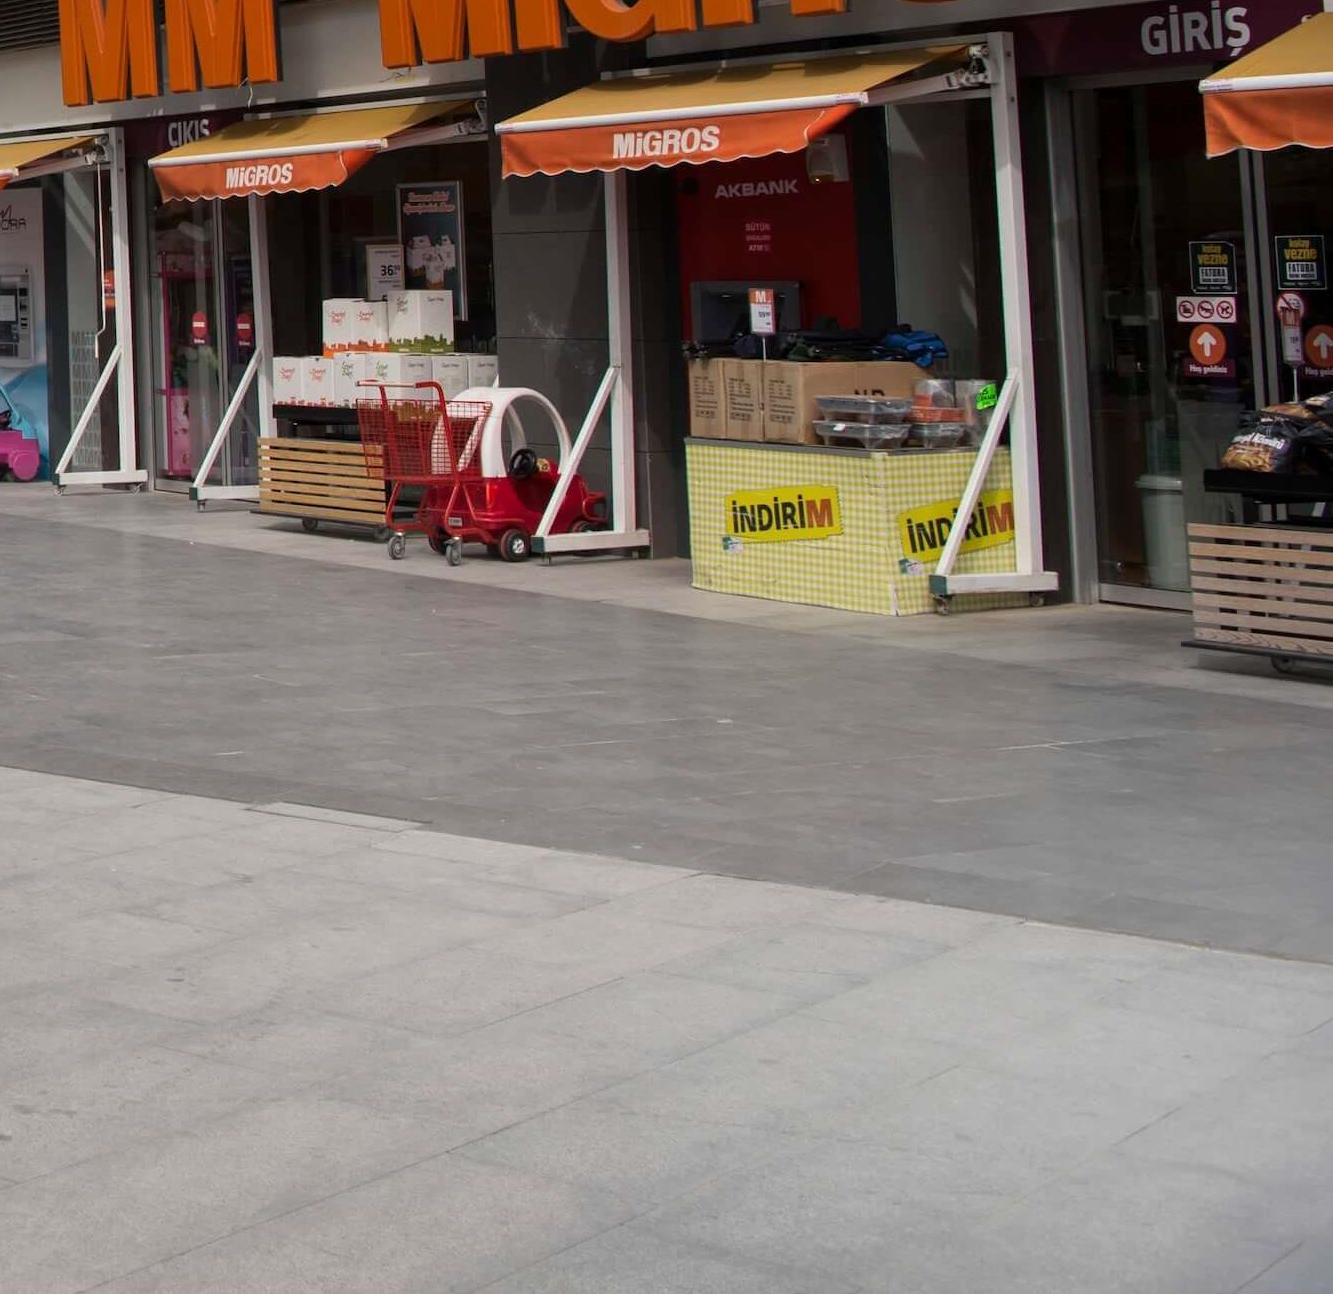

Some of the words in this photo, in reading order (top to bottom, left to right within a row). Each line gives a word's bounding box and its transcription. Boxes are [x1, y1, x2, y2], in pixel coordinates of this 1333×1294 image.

[1141, 0, 1251, 57] GİRİŞ
[613, 125, 720, 159] MiGROS
[225, 163, 293, 189] MiGROS
[714, 179, 798, 199] AKBANK
[733, 494, 833, 533] İNDİRİM
